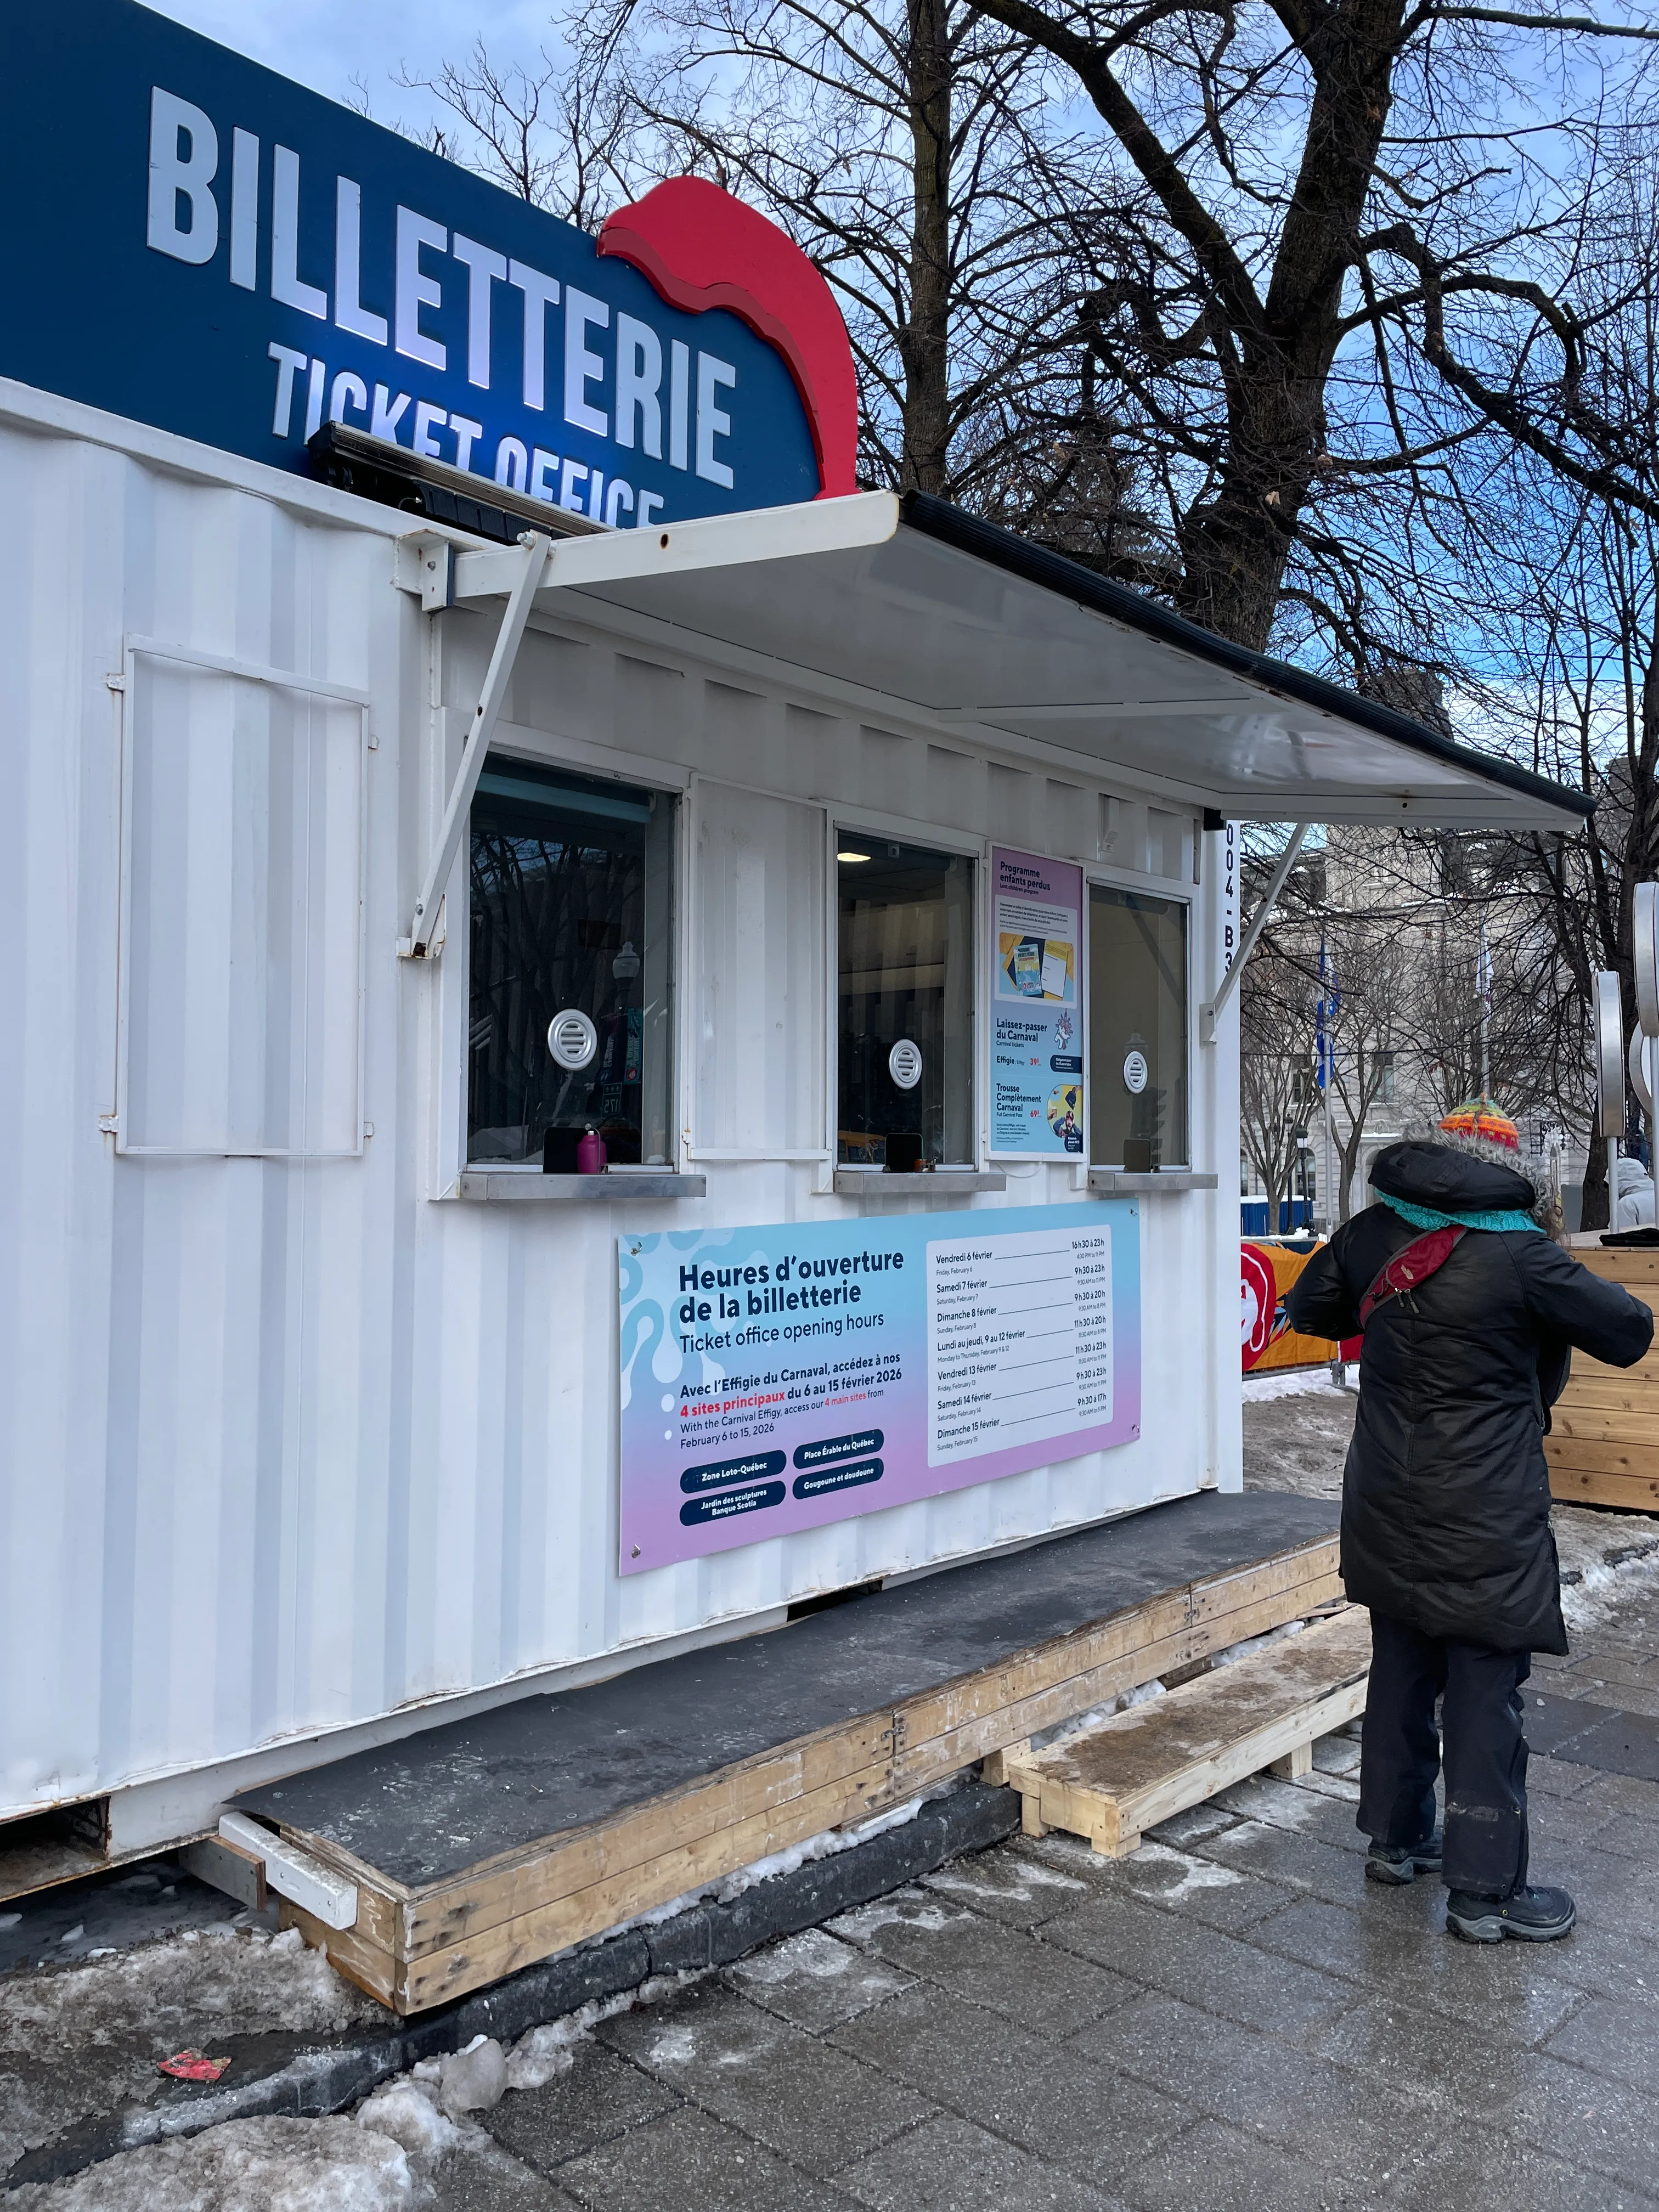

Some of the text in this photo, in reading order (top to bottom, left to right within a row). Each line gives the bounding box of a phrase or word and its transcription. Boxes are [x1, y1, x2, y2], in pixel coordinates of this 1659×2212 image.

[146, 86, 736, 490] BILLETTERIE
[1000, 861, 1040, 878] Programme
[1000, 873, 1050, 890] enfants perdus
[996, 1018, 1047, 1032] Laissez-passer
[996, 1030, 1038, 1042] du Carnaval
[996, 1056, 1014, 1066] Effigie
[996, 1084, 1019, 1092] Trousse
[996, 1094, 1041, 1103] Complètement
[996, 1103, 1023, 1111] Carnaval
[1090, 1239, 1093, 1247] à
[935, 1250, 992, 1263] Vendredi 6 février
[679, 1251, 904, 1291] Heures d'ouverture
[1090, 1265, 1093, 1273] à
[936, 1279, 987, 1293] Samedi 7 février
[679, 1279, 861, 1323] de la billetterie
[1090, 1291, 1093, 1299] à
[937, 1306, 996, 1322] Dimanche 8 février
[679, 1313, 884, 1353] Ticket office opening hours
[938, 1340, 956, 1351] Lundi
[966, 1335, 983, 1348] jeudi,
[985, 1334, 989, 1343] 9
[998, 1331, 1005, 1341] 12
[1006, 1329, 1025, 1340] février
[1092, 1342, 1095, 1351] à
[680, 1353, 900, 1398] Avec l'Effigie du Carnaval, accédez à nos
[937, 1362, 996, 1380] Vendredi 13 février
[680, 1368, 901, 1417] 4 sites principaux du 6 au 15 février 2026
[938, 1392, 991, 1409] Samedi 14 février
[1093, 1395, 1096, 1403] à
[680, 1421, 702, 1433] With
[704, 1419, 719, 1429] the
[721, 1410, 755, 1426] Carnival
[758, 1408, 782, 1419] Effigy,
[784, 1403, 809, 1414] access
[811, 1401, 823, 1409] our
[825, 1397, 829, 1406] 4
[850, 1393, 866, 1401] sites
[867, 1390, 883, 1398] from
[937, 1413, 957, 1421] Saturday,
[680, 1422, 774, 1448] February 6 to 15, 2026
[938, 1418, 1000, 1438] Dimanche 15 février
[804, 1451, 821, 1459] Place
[822, 1445, 842, 1455] Érable
[851, 1439, 874, 1449] Québec
[936, 1442, 953, 1451] Sunday,
[954, 1438, 973, 1447] February
[702, 1463, 767, 1481] Zone Loto-Québec
[804, 1477, 836, 1489] Gougoune
[844, 1468, 873, 1480] doudoune
[701, 1499, 721, 1509] Jardin
[735, 1489, 766, 1504] sculptures
[712, 1499, 756, 1515] Banque Scotia
